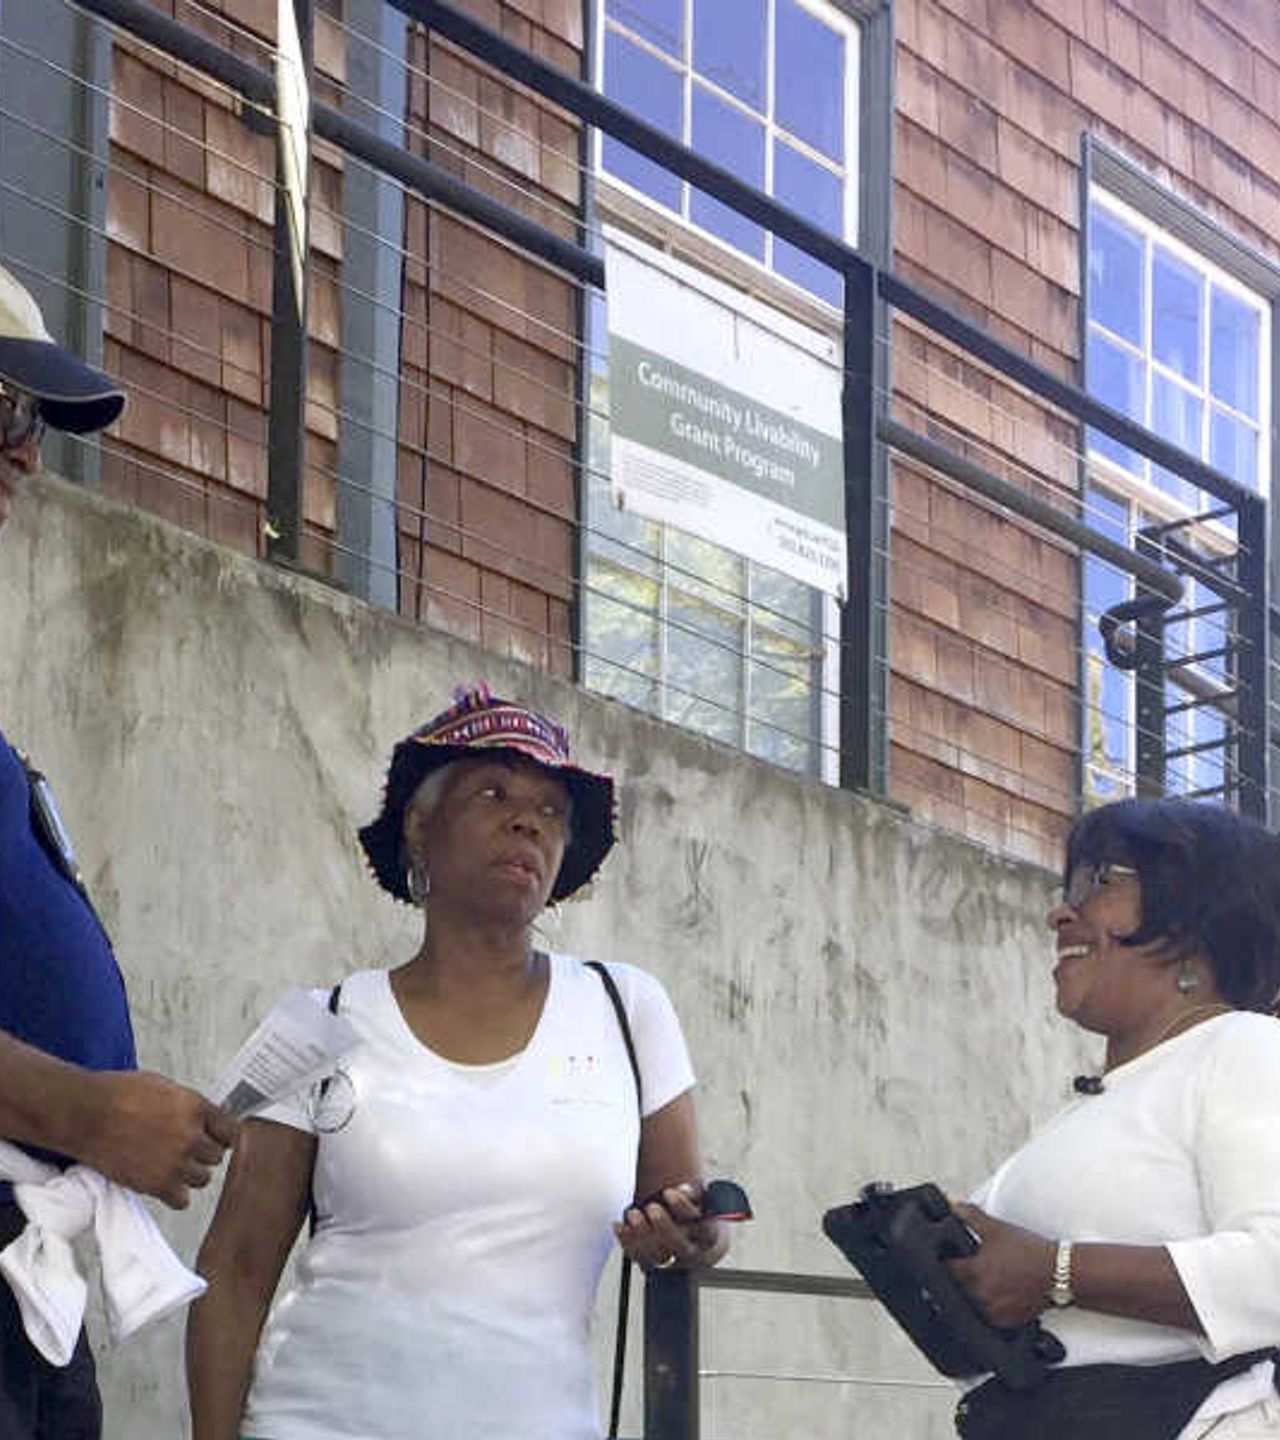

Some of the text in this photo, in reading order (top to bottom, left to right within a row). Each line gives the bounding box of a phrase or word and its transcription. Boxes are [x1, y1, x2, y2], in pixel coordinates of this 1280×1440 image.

[637, 361, 820, 469] Community Livability
[670, 412, 722, 455] Grant
[723, 436, 796, 489] Program
